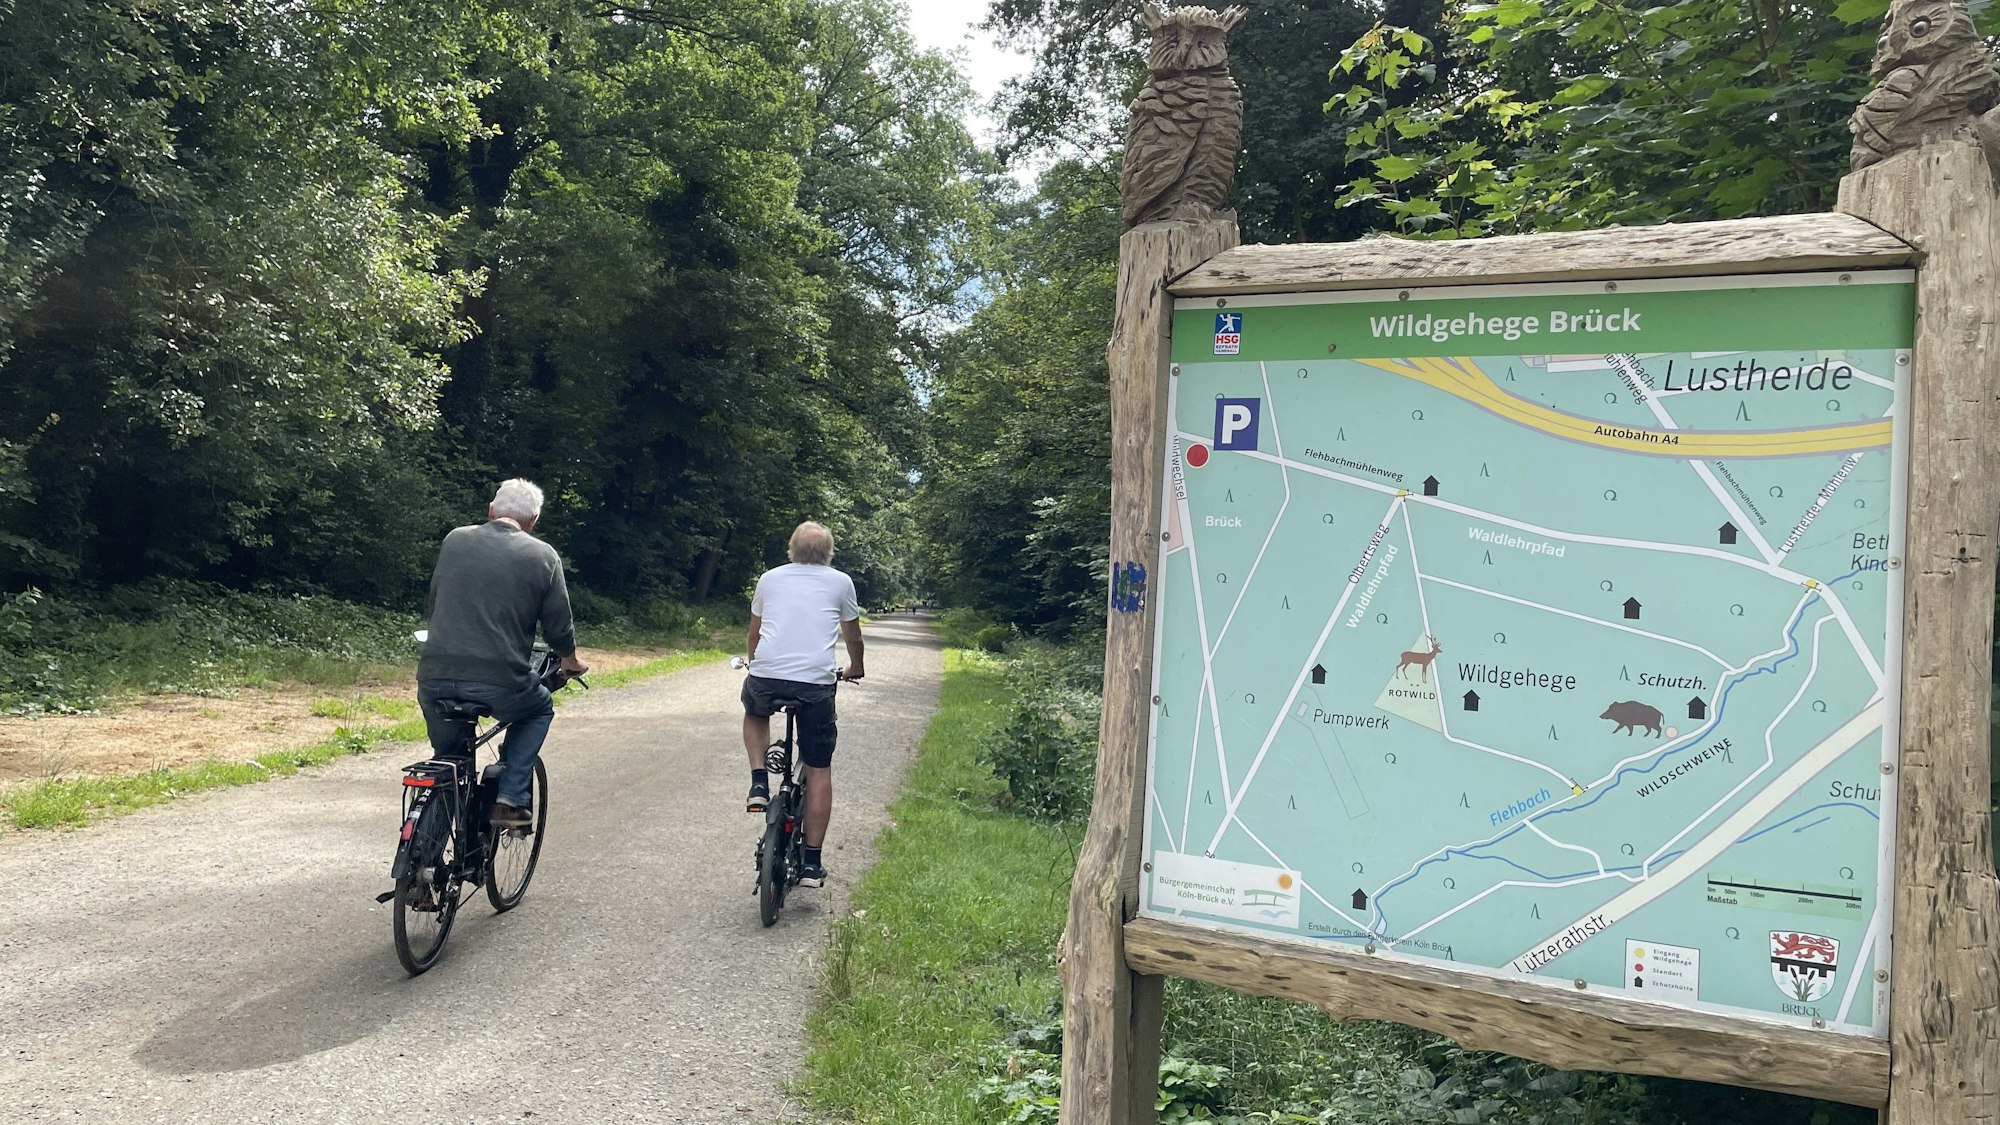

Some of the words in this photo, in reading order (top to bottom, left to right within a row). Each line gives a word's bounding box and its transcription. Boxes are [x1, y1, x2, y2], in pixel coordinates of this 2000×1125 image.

[1370, 311, 1539, 342] Wildgehege
[1550, 307, 1641, 333] Brück
[1216, 335, 1239, 344] HSG
[1664, 357, 1852, 392] Lustheide
[1221, 405, 1251, 444] P
[1594, 425, 1658, 444] Autobahn
[1662, 434, 1680, 445] A4
[1304, 448, 1404, 482] Flehbachmühlenweg
[1716, 461, 1767, 526] Flehbachmühlenweg
[1205, 515, 1242, 528] Brück
[1778, 500, 1823, 553] Lustheider
[1348, 524, 1390, 584] Olbertsweg
[1468, 526, 1565, 558] Waldlehrpfad
[1346, 544, 1399, 629] Waldlehrpfad
[1458, 663, 1576, 693] Wildgehege
[1638, 672, 1707, 691] Schutzh.
[1388, 689, 1436, 700] ROTWILD
[1313, 709, 1390, 730] Pumpwerk
[1636, 738, 1733, 798] WILDSCHWEINE
[1490, 787, 1551, 827] Flehbach
[1160, 876, 1236, 895] Bürgergemeinschaft
[1177, 889, 1219, 904] Köln-Brück
[1221, 896, 1235, 906] e.V.
[1707, 895, 1738, 905] Maßstab
[1846, 902, 1862, 910] 300m
[1308, 922, 1331, 933] Erstellt
[1332, 926, 1352, 936] durch
[1353, 930, 1368, 939] den
[1414, 939, 1430, 949] Köln
[1513, 914, 1614, 974] Lützerathstr.
[1653, 949, 1680, 958] Eingang
[1653, 955, 1692, 966] Wildgehege
[1652, 968, 1682, 977] Standort
[1652, 980, 1693, 991] Schutzhütte
